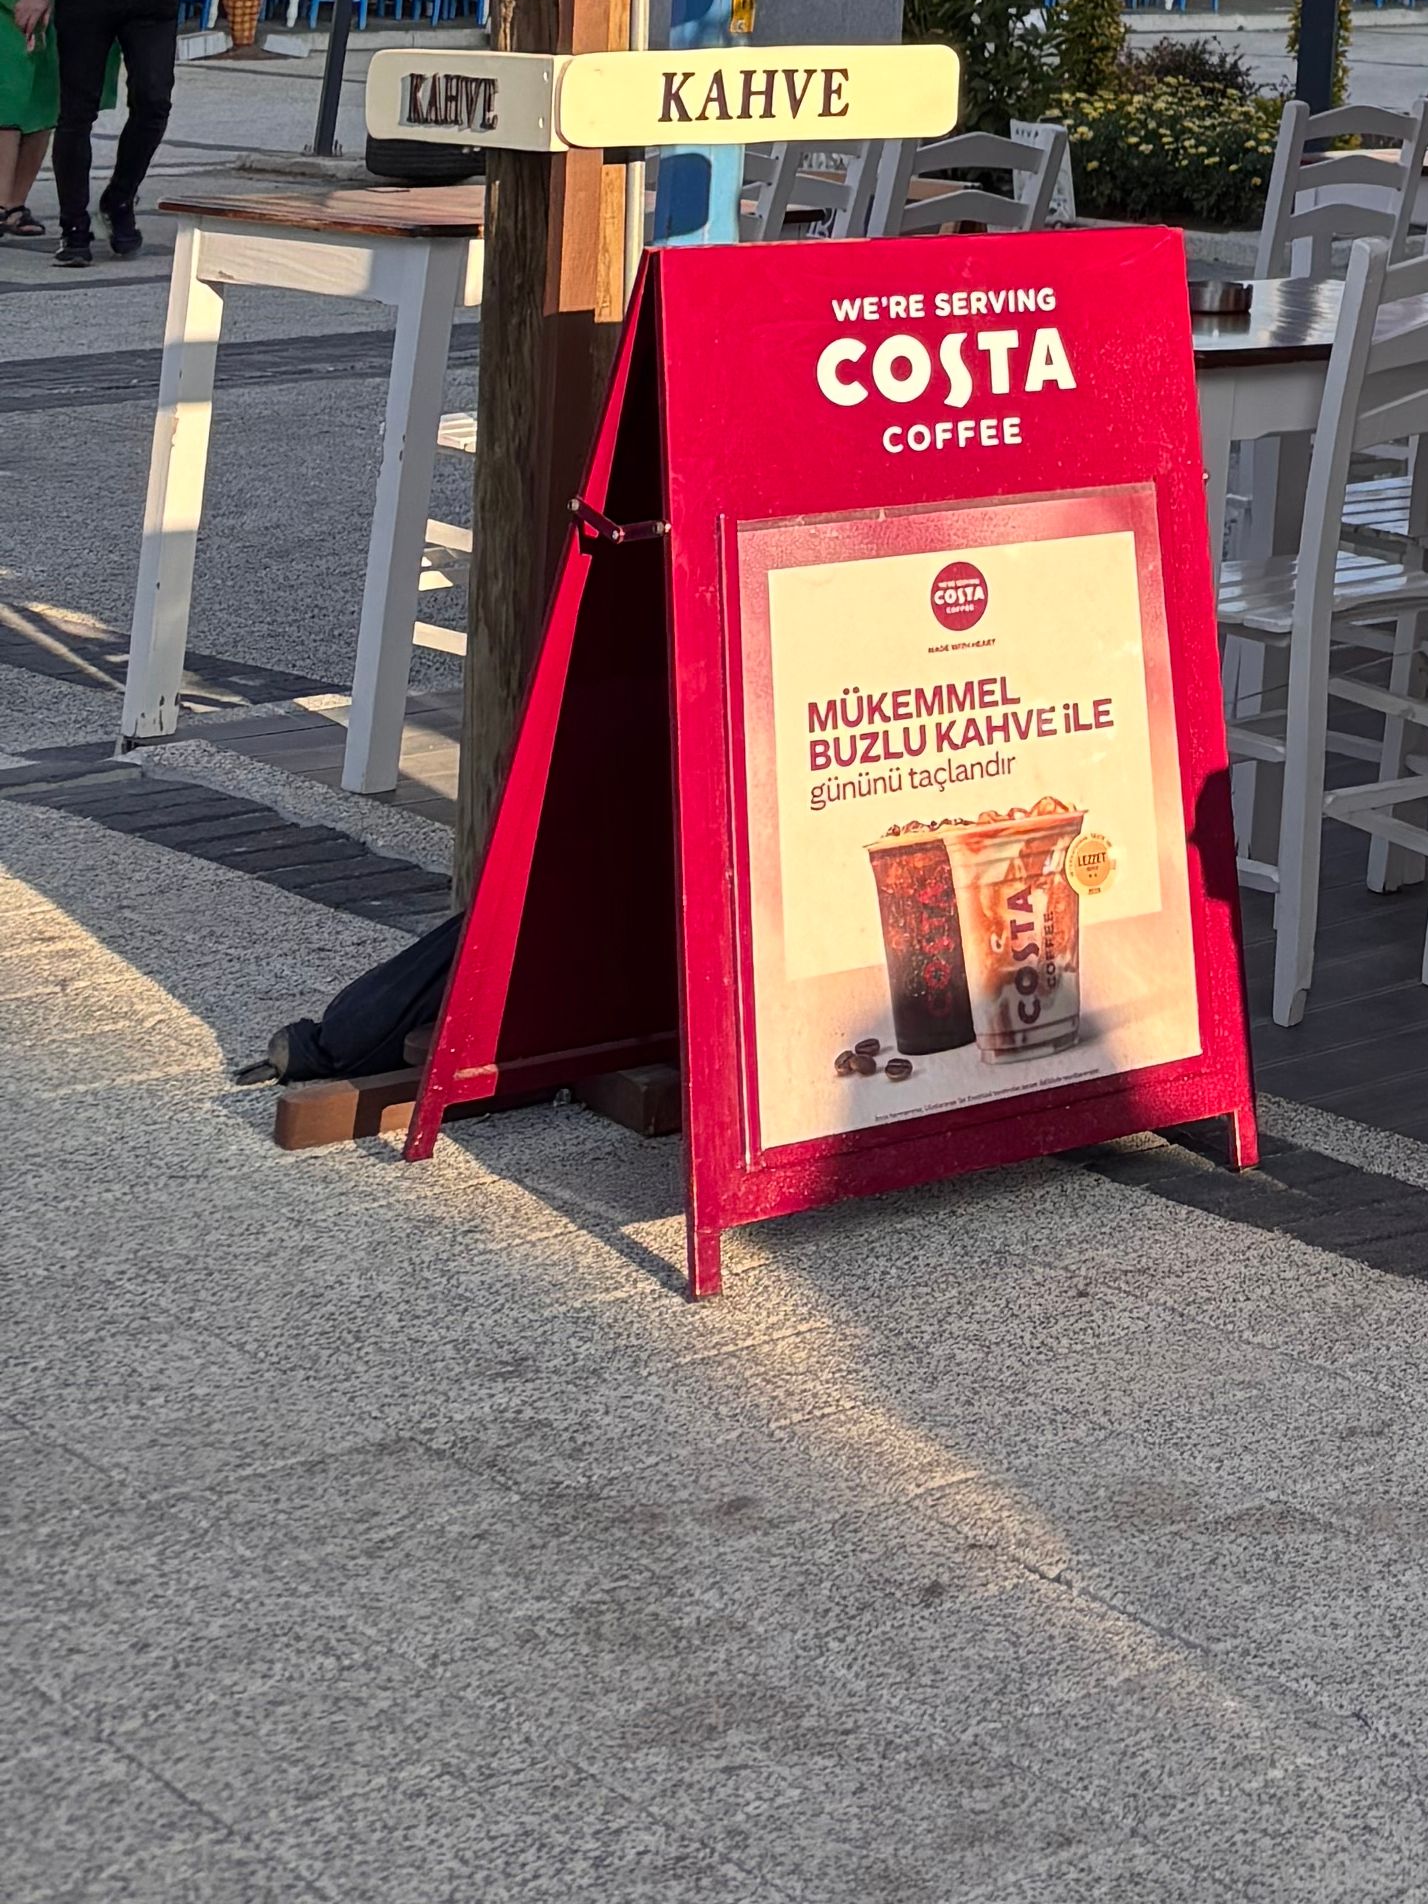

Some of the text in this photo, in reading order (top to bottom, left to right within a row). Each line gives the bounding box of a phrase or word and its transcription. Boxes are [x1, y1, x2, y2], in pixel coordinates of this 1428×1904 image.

[407, 72, 499, 131] KAHVE
[657, 67, 851, 123] KAHVE
[831, 287, 1057, 322] WE'RE SERVING
[816, 327, 1078, 409] COSTA
[882, 416, 1023, 454] COFFEE
[933, 585, 985, 605] COSTA
[808, 676, 1021, 734] MÜKEMMEL
[809, 724, 927, 772] BUZLU
[935, 705, 1057, 753] KAHVE
[809, 751, 1016, 811] gününü taçlandır
[1077, 852, 1106, 867] LEZZET
[1007, 884, 1041, 1024] COSTA
